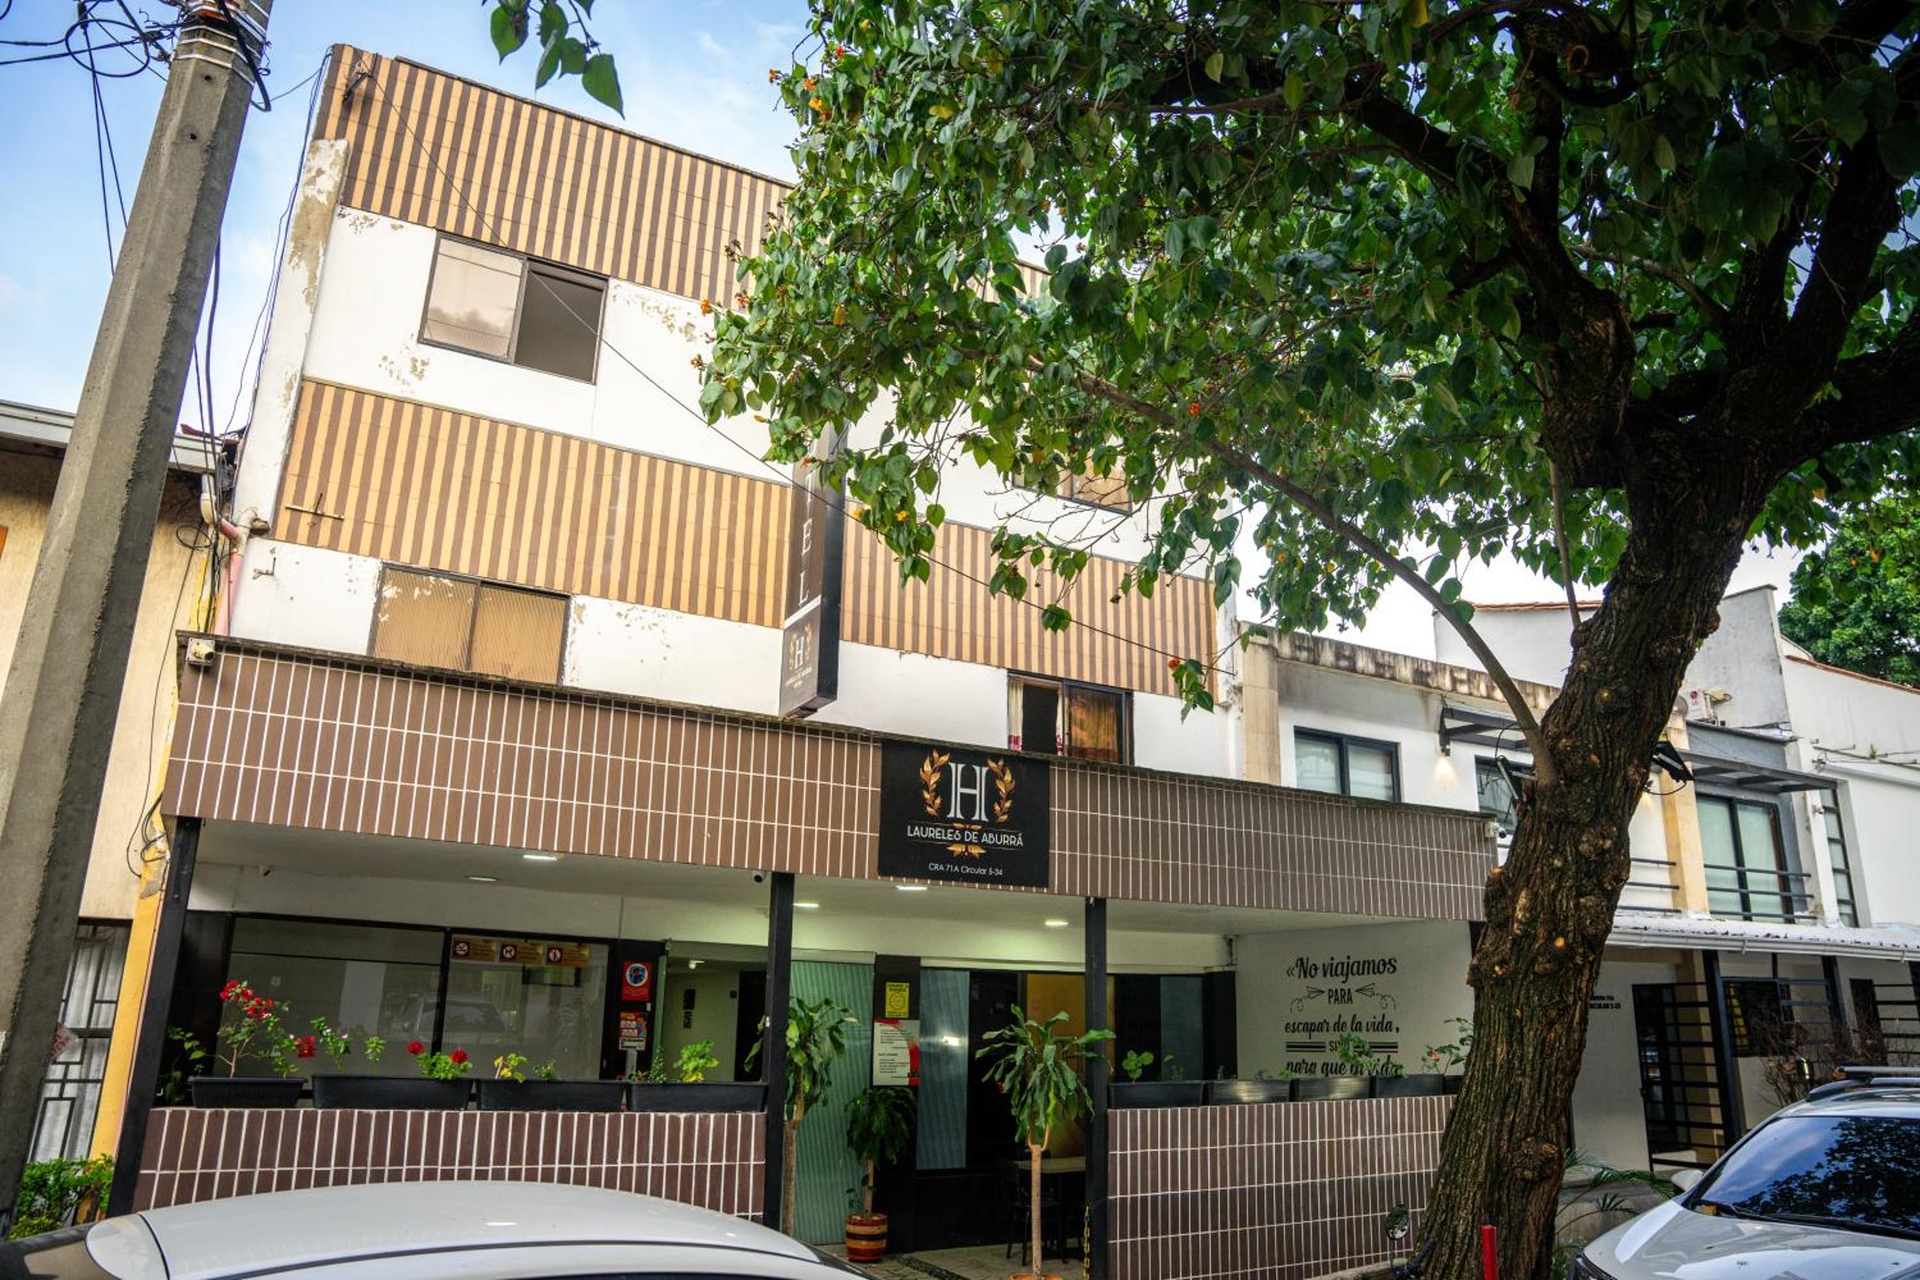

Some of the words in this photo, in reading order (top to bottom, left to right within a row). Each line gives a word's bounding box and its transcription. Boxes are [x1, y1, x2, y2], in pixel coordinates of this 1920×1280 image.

[794, 635, 805, 670] H
[946, 762, 990, 822] H
[907, 825, 961, 841] LAURELES
[964, 830, 979, 844] DE
[981, 832, 1024, 848] ABURRÁ
[928, 862, 944, 873] CRA
[945, 864, 960, 873] 71A
[1322, 955, 1397, 984] viajamos
[1327, 988, 1354, 1005] PARA
[1284, 1018, 1330, 1040] escapar
[1332, 1013, 1348, 1033] de
[1350, 1013, 1363, 1033] la
[1320, 1060, 1347, 1077] que
